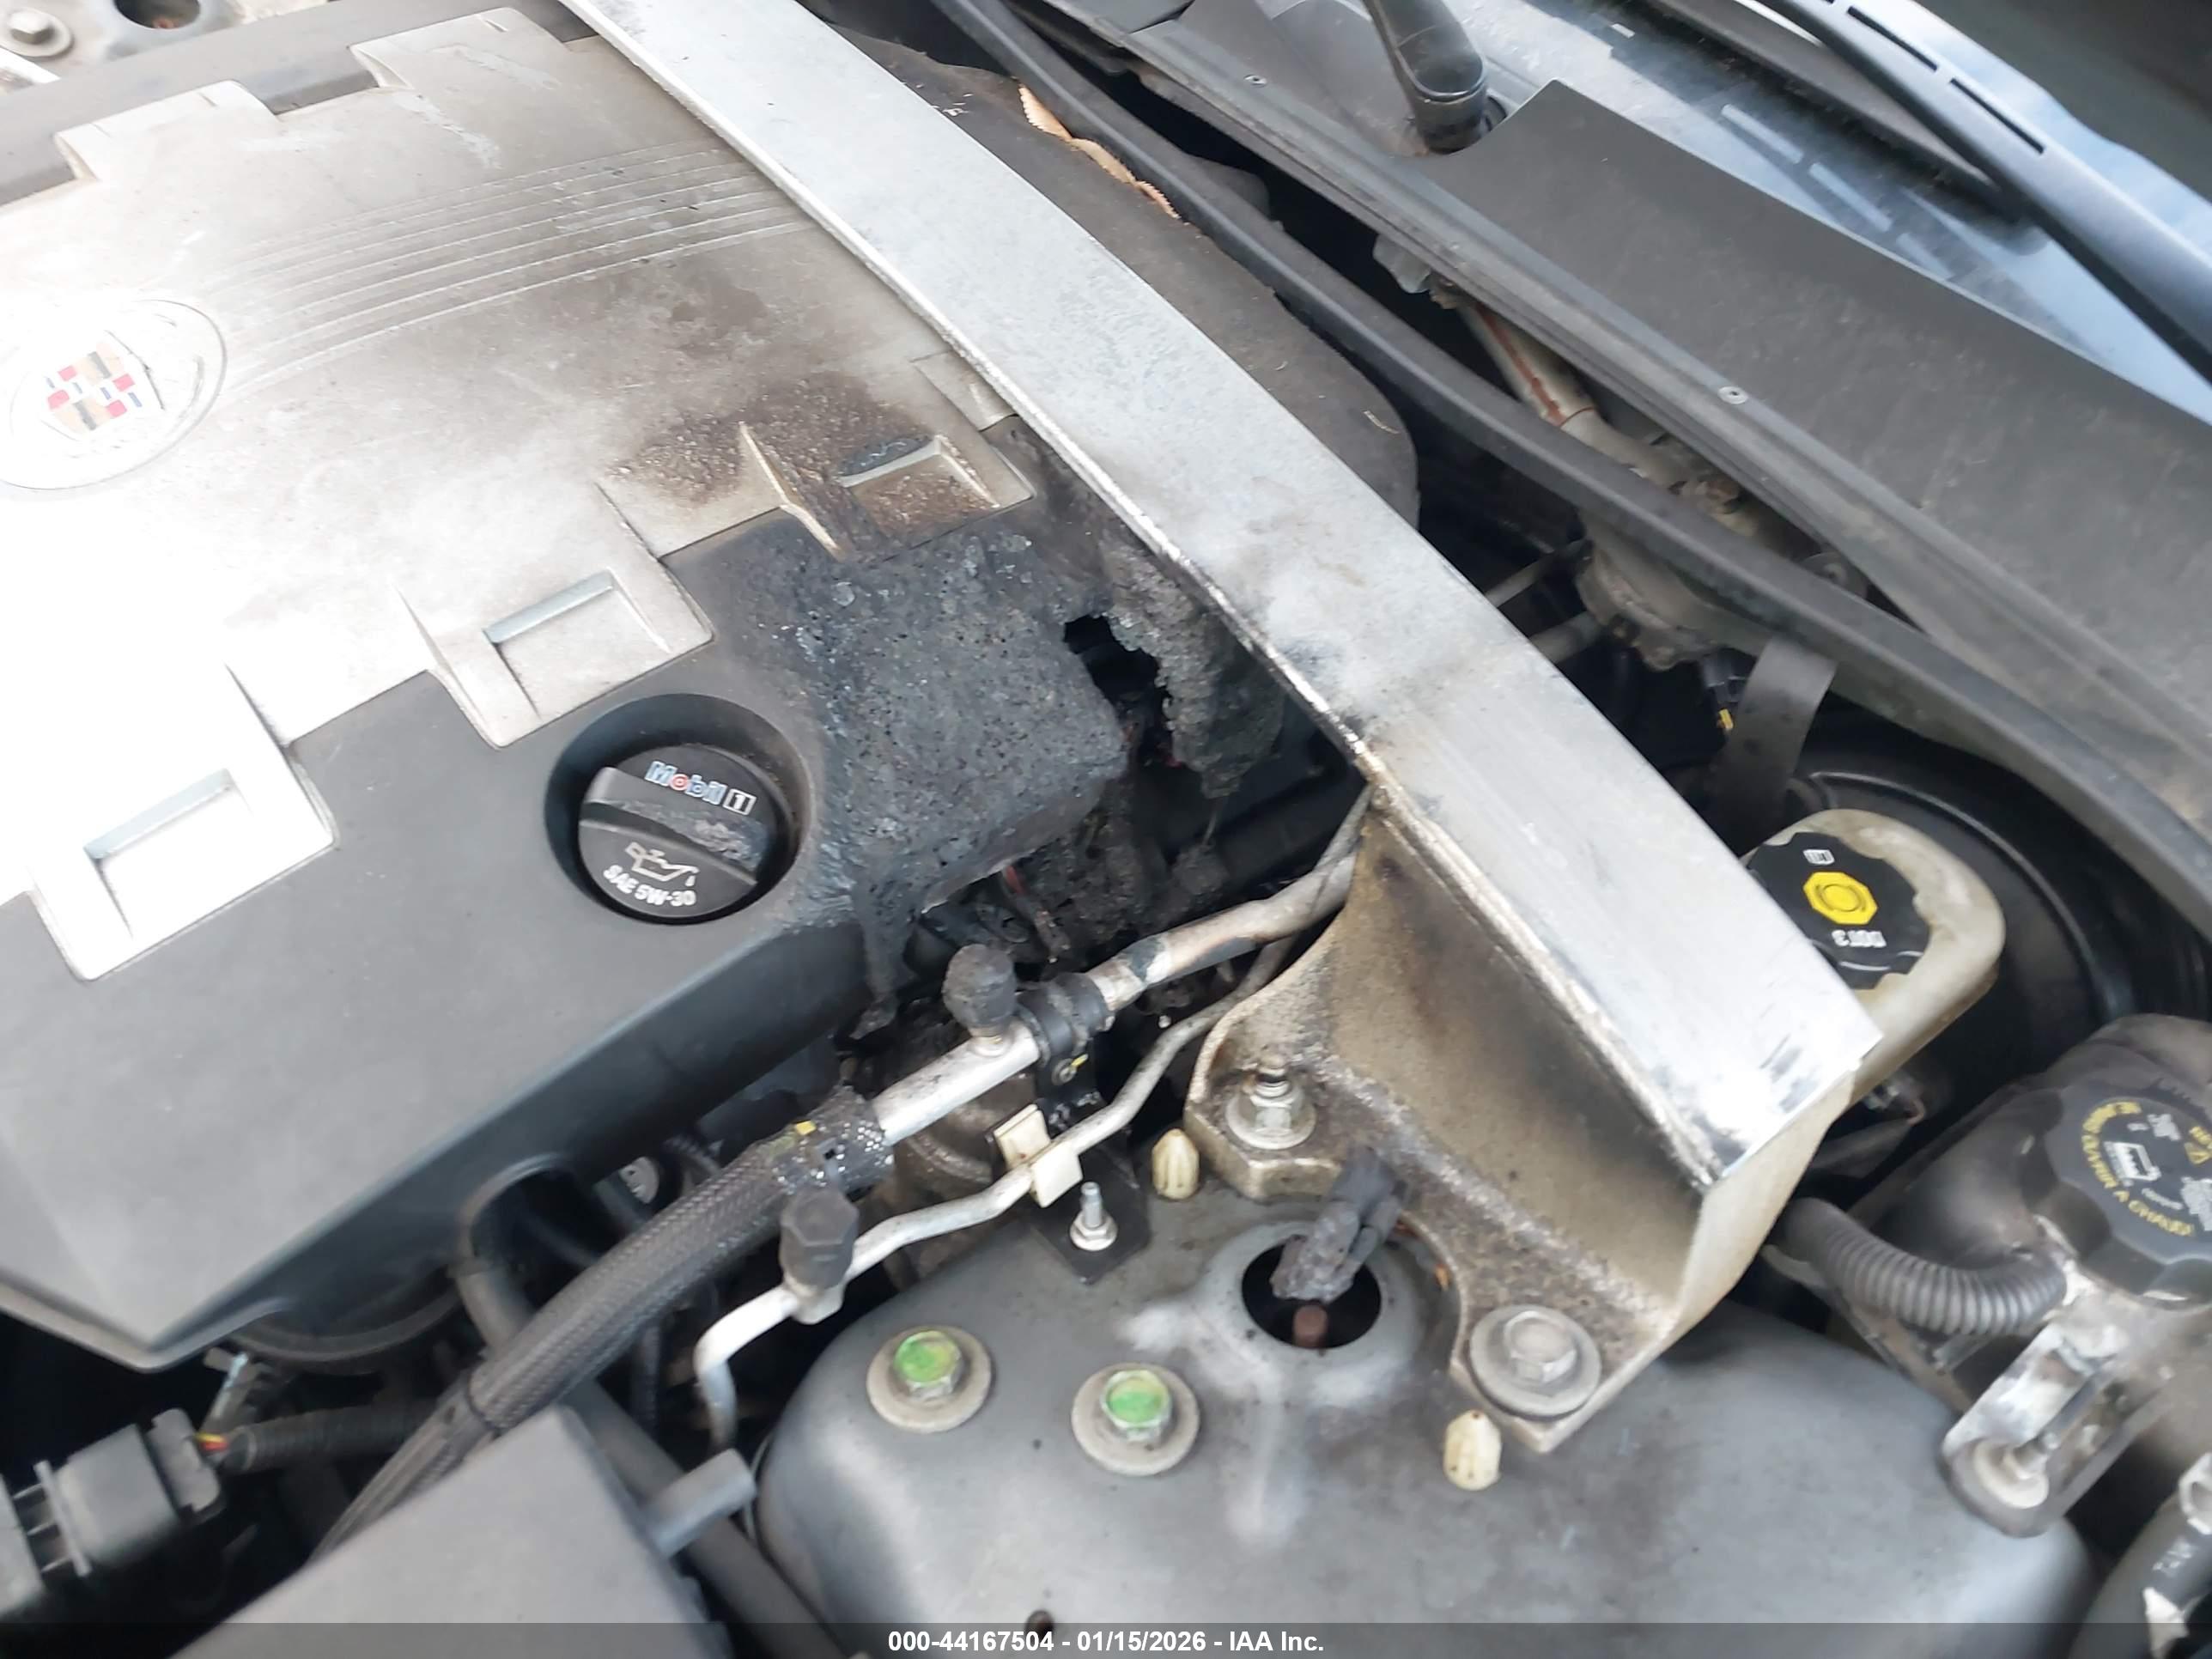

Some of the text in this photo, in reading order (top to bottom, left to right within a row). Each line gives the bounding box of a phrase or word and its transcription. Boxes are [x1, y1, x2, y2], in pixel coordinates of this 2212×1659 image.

[645, 761, 728, 805] Mobil
[603, 864, 696, 906] SAE 5W-30
